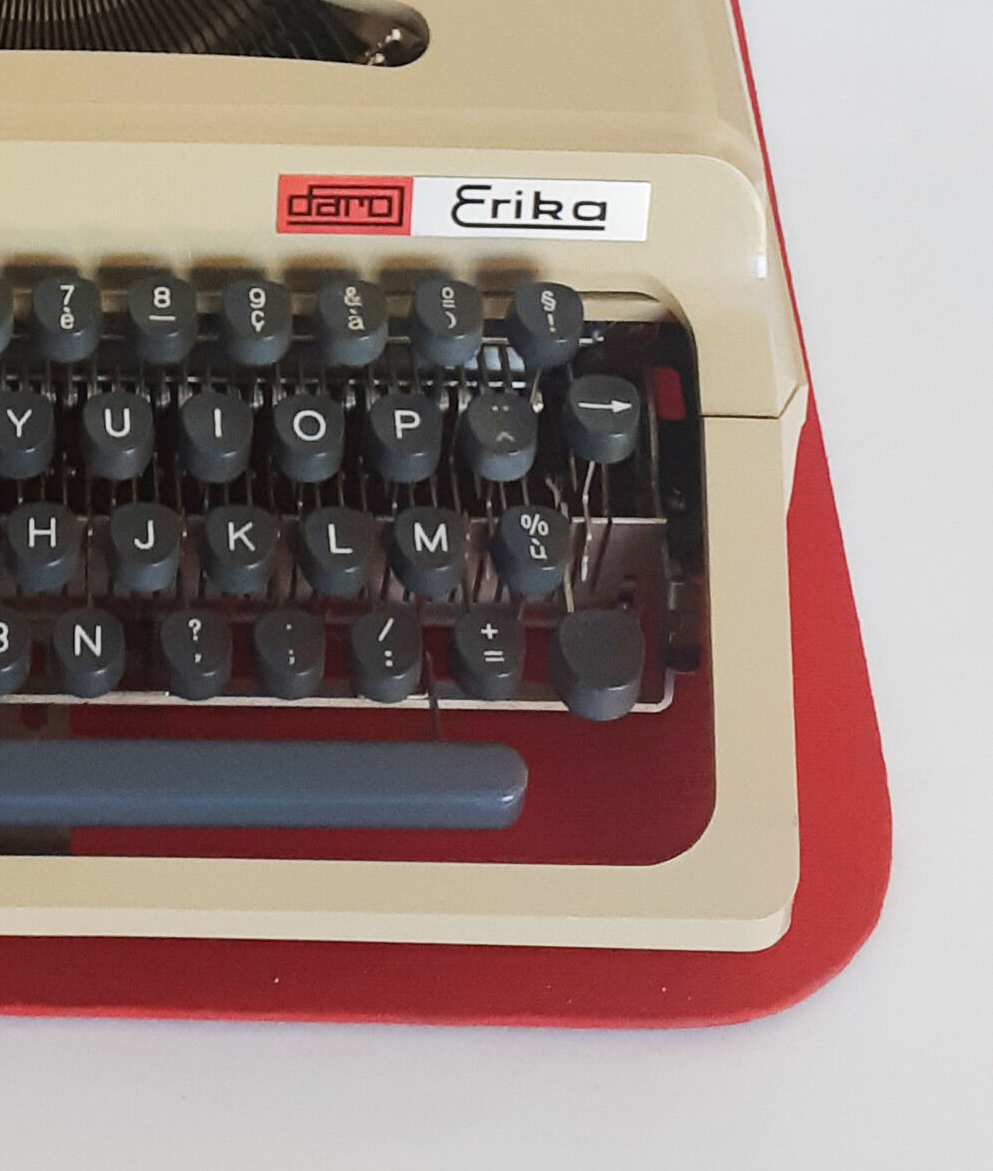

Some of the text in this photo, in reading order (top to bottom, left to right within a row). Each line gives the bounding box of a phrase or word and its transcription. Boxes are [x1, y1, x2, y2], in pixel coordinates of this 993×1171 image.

[287, 184, 404, 226] daro
[451, 183, 608, 230] Erika
[59, 284, 75, 309] 7
[153, 286, 171, 309] 8
[248, 287, 266, 312] 9
[343, 286, 362, 307] &
[60, 306, 75, 330] è
[251, 309, 265, 332] ç
[348, 308, 365, 330] à
[547, 313, 556, 332] !
[6, 409, 32, 438] Y
[104, 408, 131, 438] U
[214, 408, 222, 438] I
[293, 409, 327, 442] O
[394, 409, 421, 439] P
[28, 517, 57, 548] H
[134, 519, 155, 550] J
[228, 521, 256, 551] K
[520, 513, 549, 536] %
[328, 523, 353, 554] L
[414, 522, 448, 553] M
[529, 537, 548, 560] ù
[74, 624, 102, 657] N
[188, 618, 202, 641] ?
[378, 618, 394, 642] /
[480, 623, 499, 640] +
[384, 650, 393, 667] :
[483, 650, 505, 662] =
